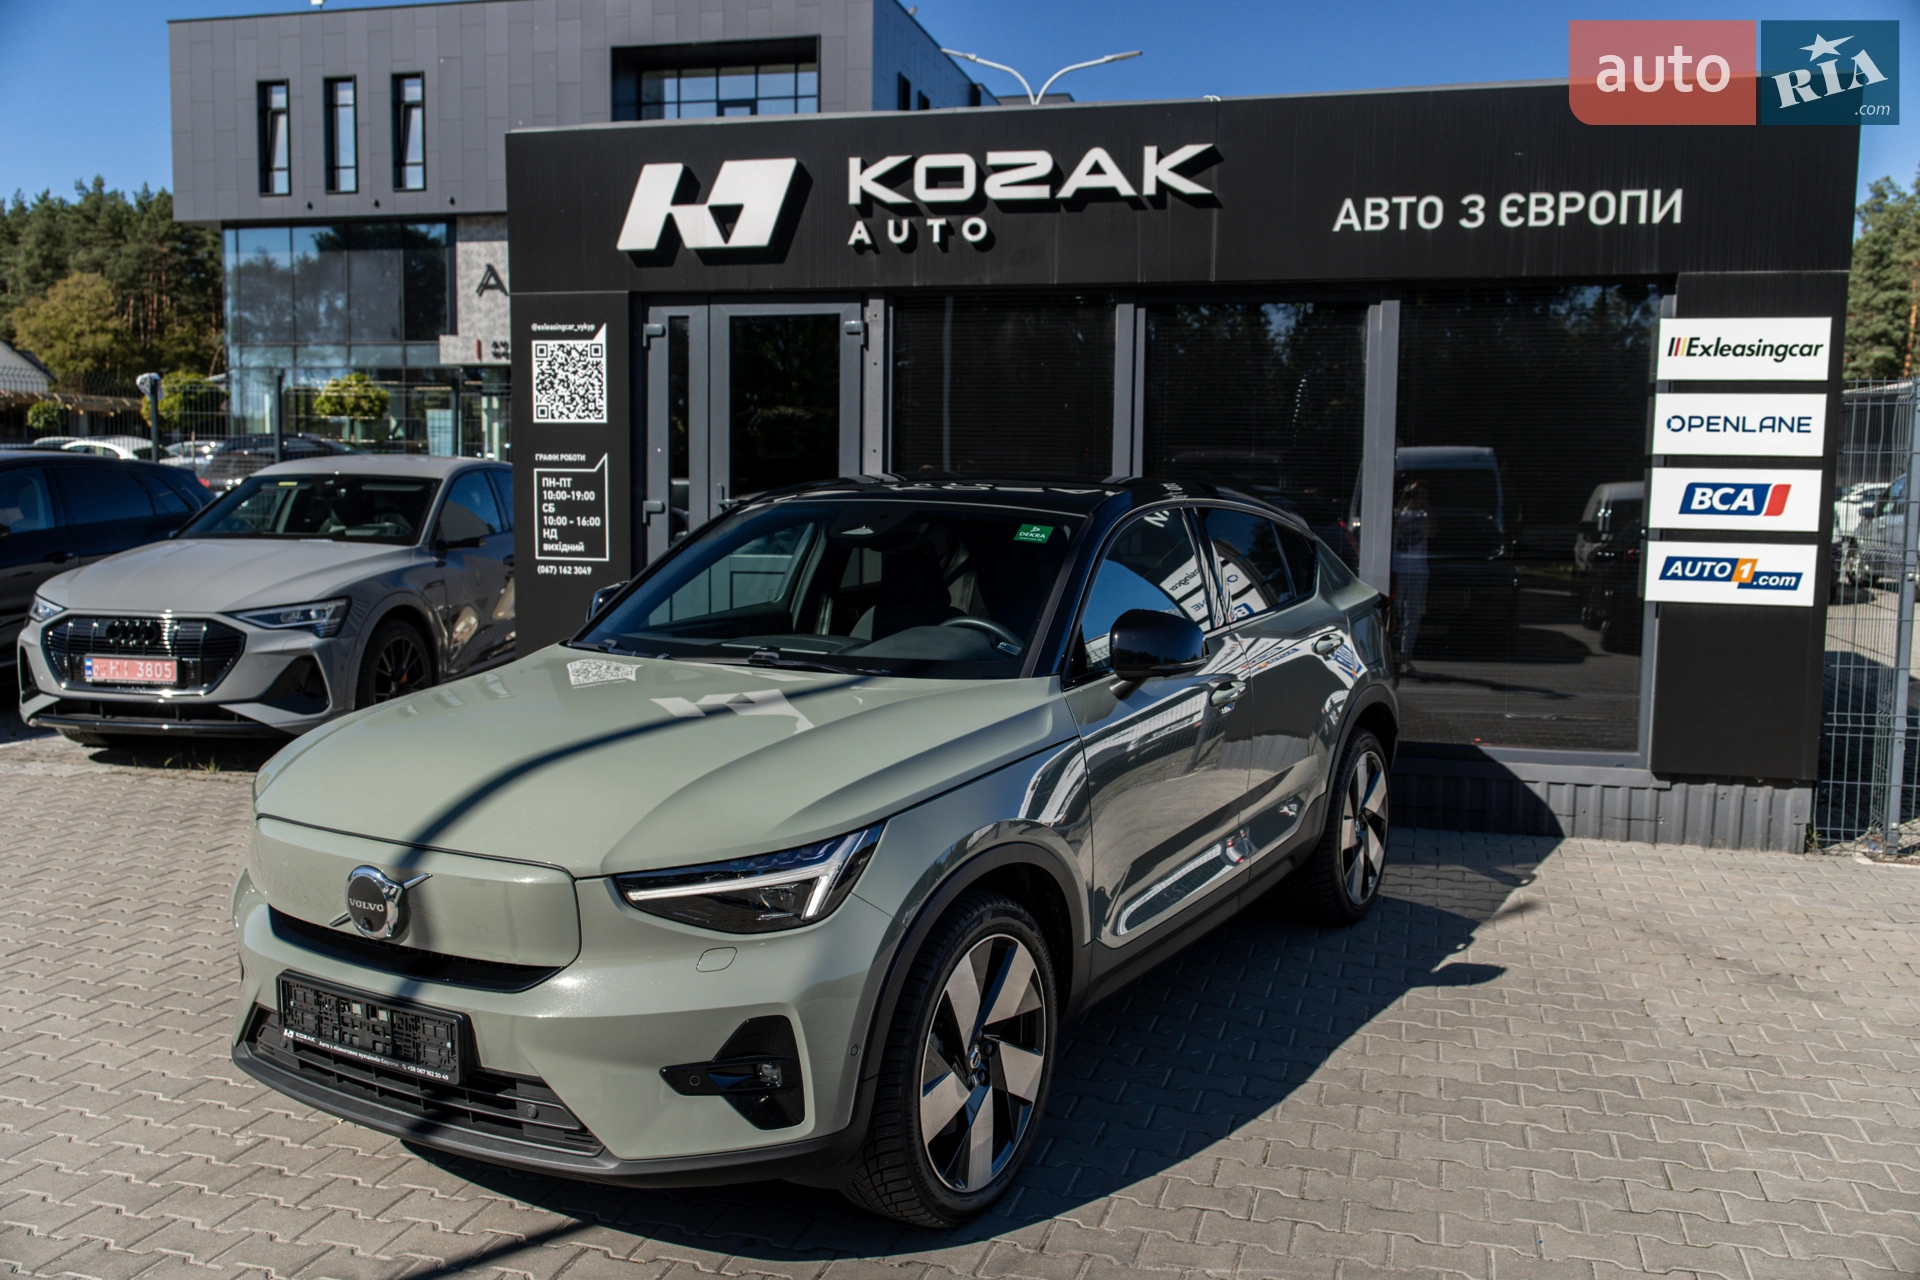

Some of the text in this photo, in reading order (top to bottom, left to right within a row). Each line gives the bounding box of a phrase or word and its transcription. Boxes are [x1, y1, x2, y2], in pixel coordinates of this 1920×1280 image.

[848, 143, 1215, 206] KOZAK
[1332, 188, 1683, 232] АВТО З ЄВРОПИ
[847, 216, 988, 246] AUTO
[1686, 337, 1824, 363] Exleasingcar
[1666, 415, 1813, 433] OPENLANE
[535, 453, 586, 462] ГРАФІК РОБОТИ
[542, 477, 573, 488] ПН-ПТ
[542, 490, 595, 501] 10:00-19:00
[1690, 487, 1755, 511] BCA
[542, 503, 555, 513] СБ
[543, 516, 567, 526] 10:00
[576, 517, 601, 527] 16:00
[543, 528, 558, 540] НД
[543, 542, 585, 553] вихідний
[537, 565, 592, 576] (067) 162 3049
[137, 662, 172, 678] 3805
[348, 898, 385, 912] VOLVO
